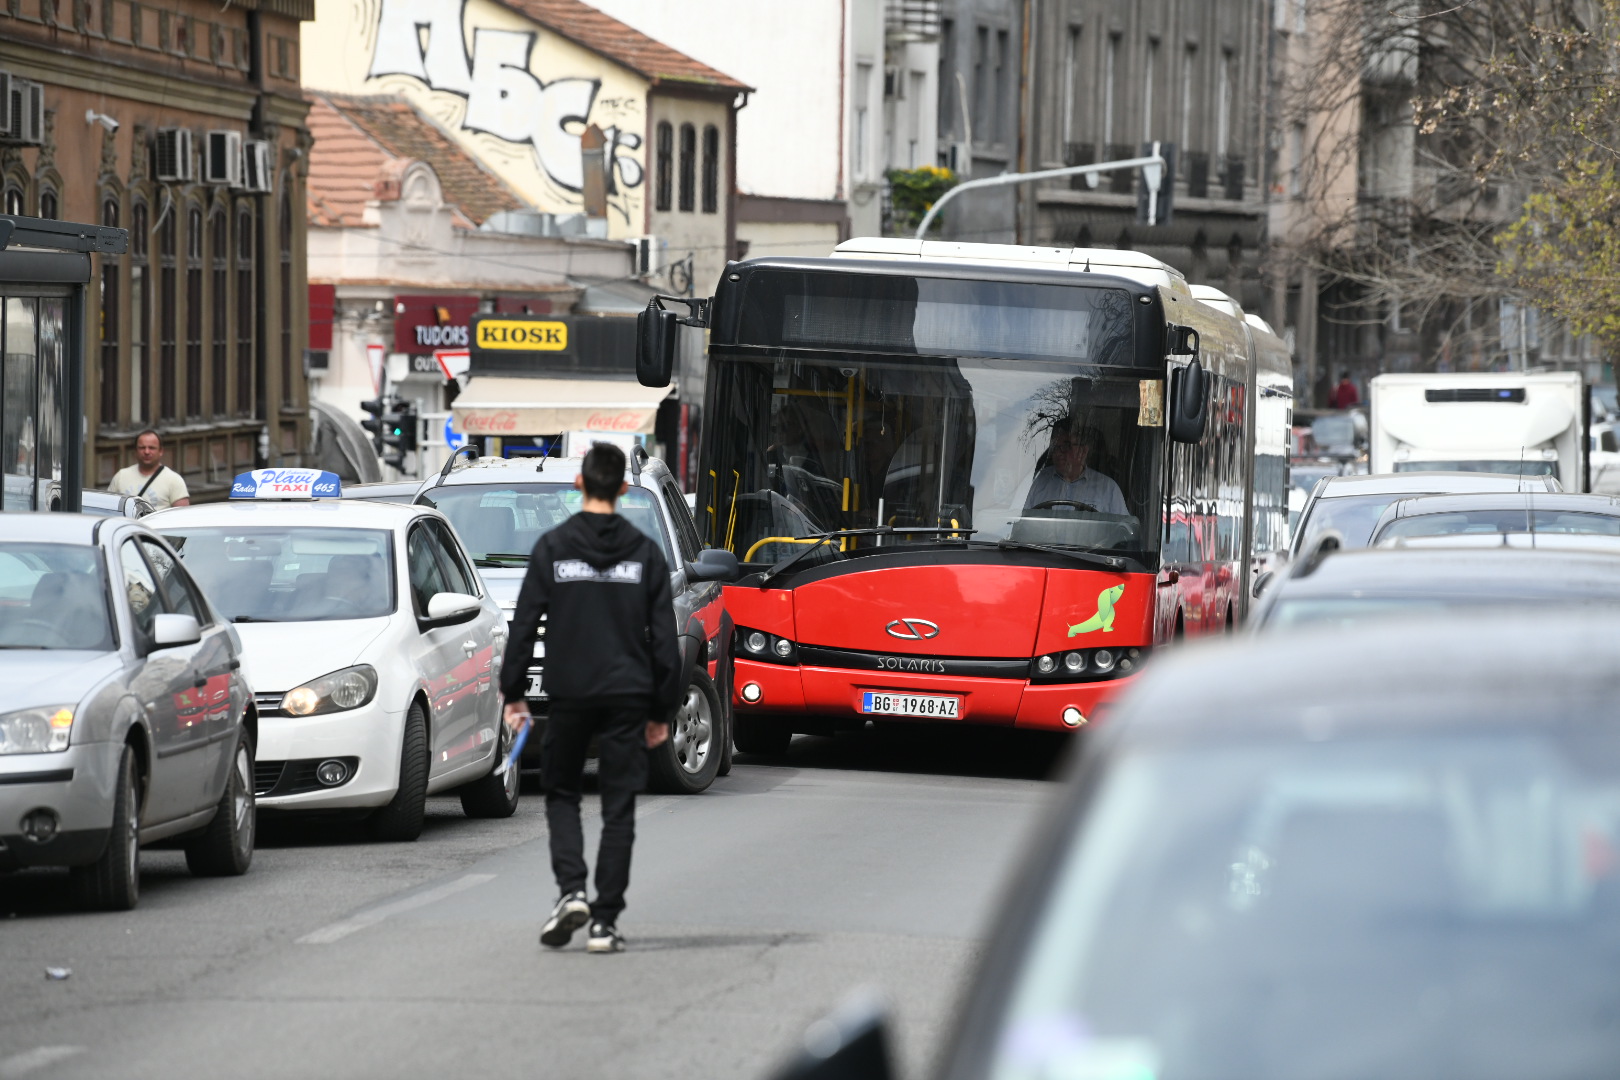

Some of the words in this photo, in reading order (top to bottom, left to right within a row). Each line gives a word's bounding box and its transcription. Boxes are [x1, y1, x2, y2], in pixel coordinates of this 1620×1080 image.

[415, 325, 469, 346] TUDORS
[481, 326, 563, 344] KIOSK
[259, 470, 313, 487] Plavi
[232, 482, 256, 493] Radio
[313, 483, 336, 493] 465
[877, 657, 945, 672] SOLARIS
[874, 696, 891, 711] BG
